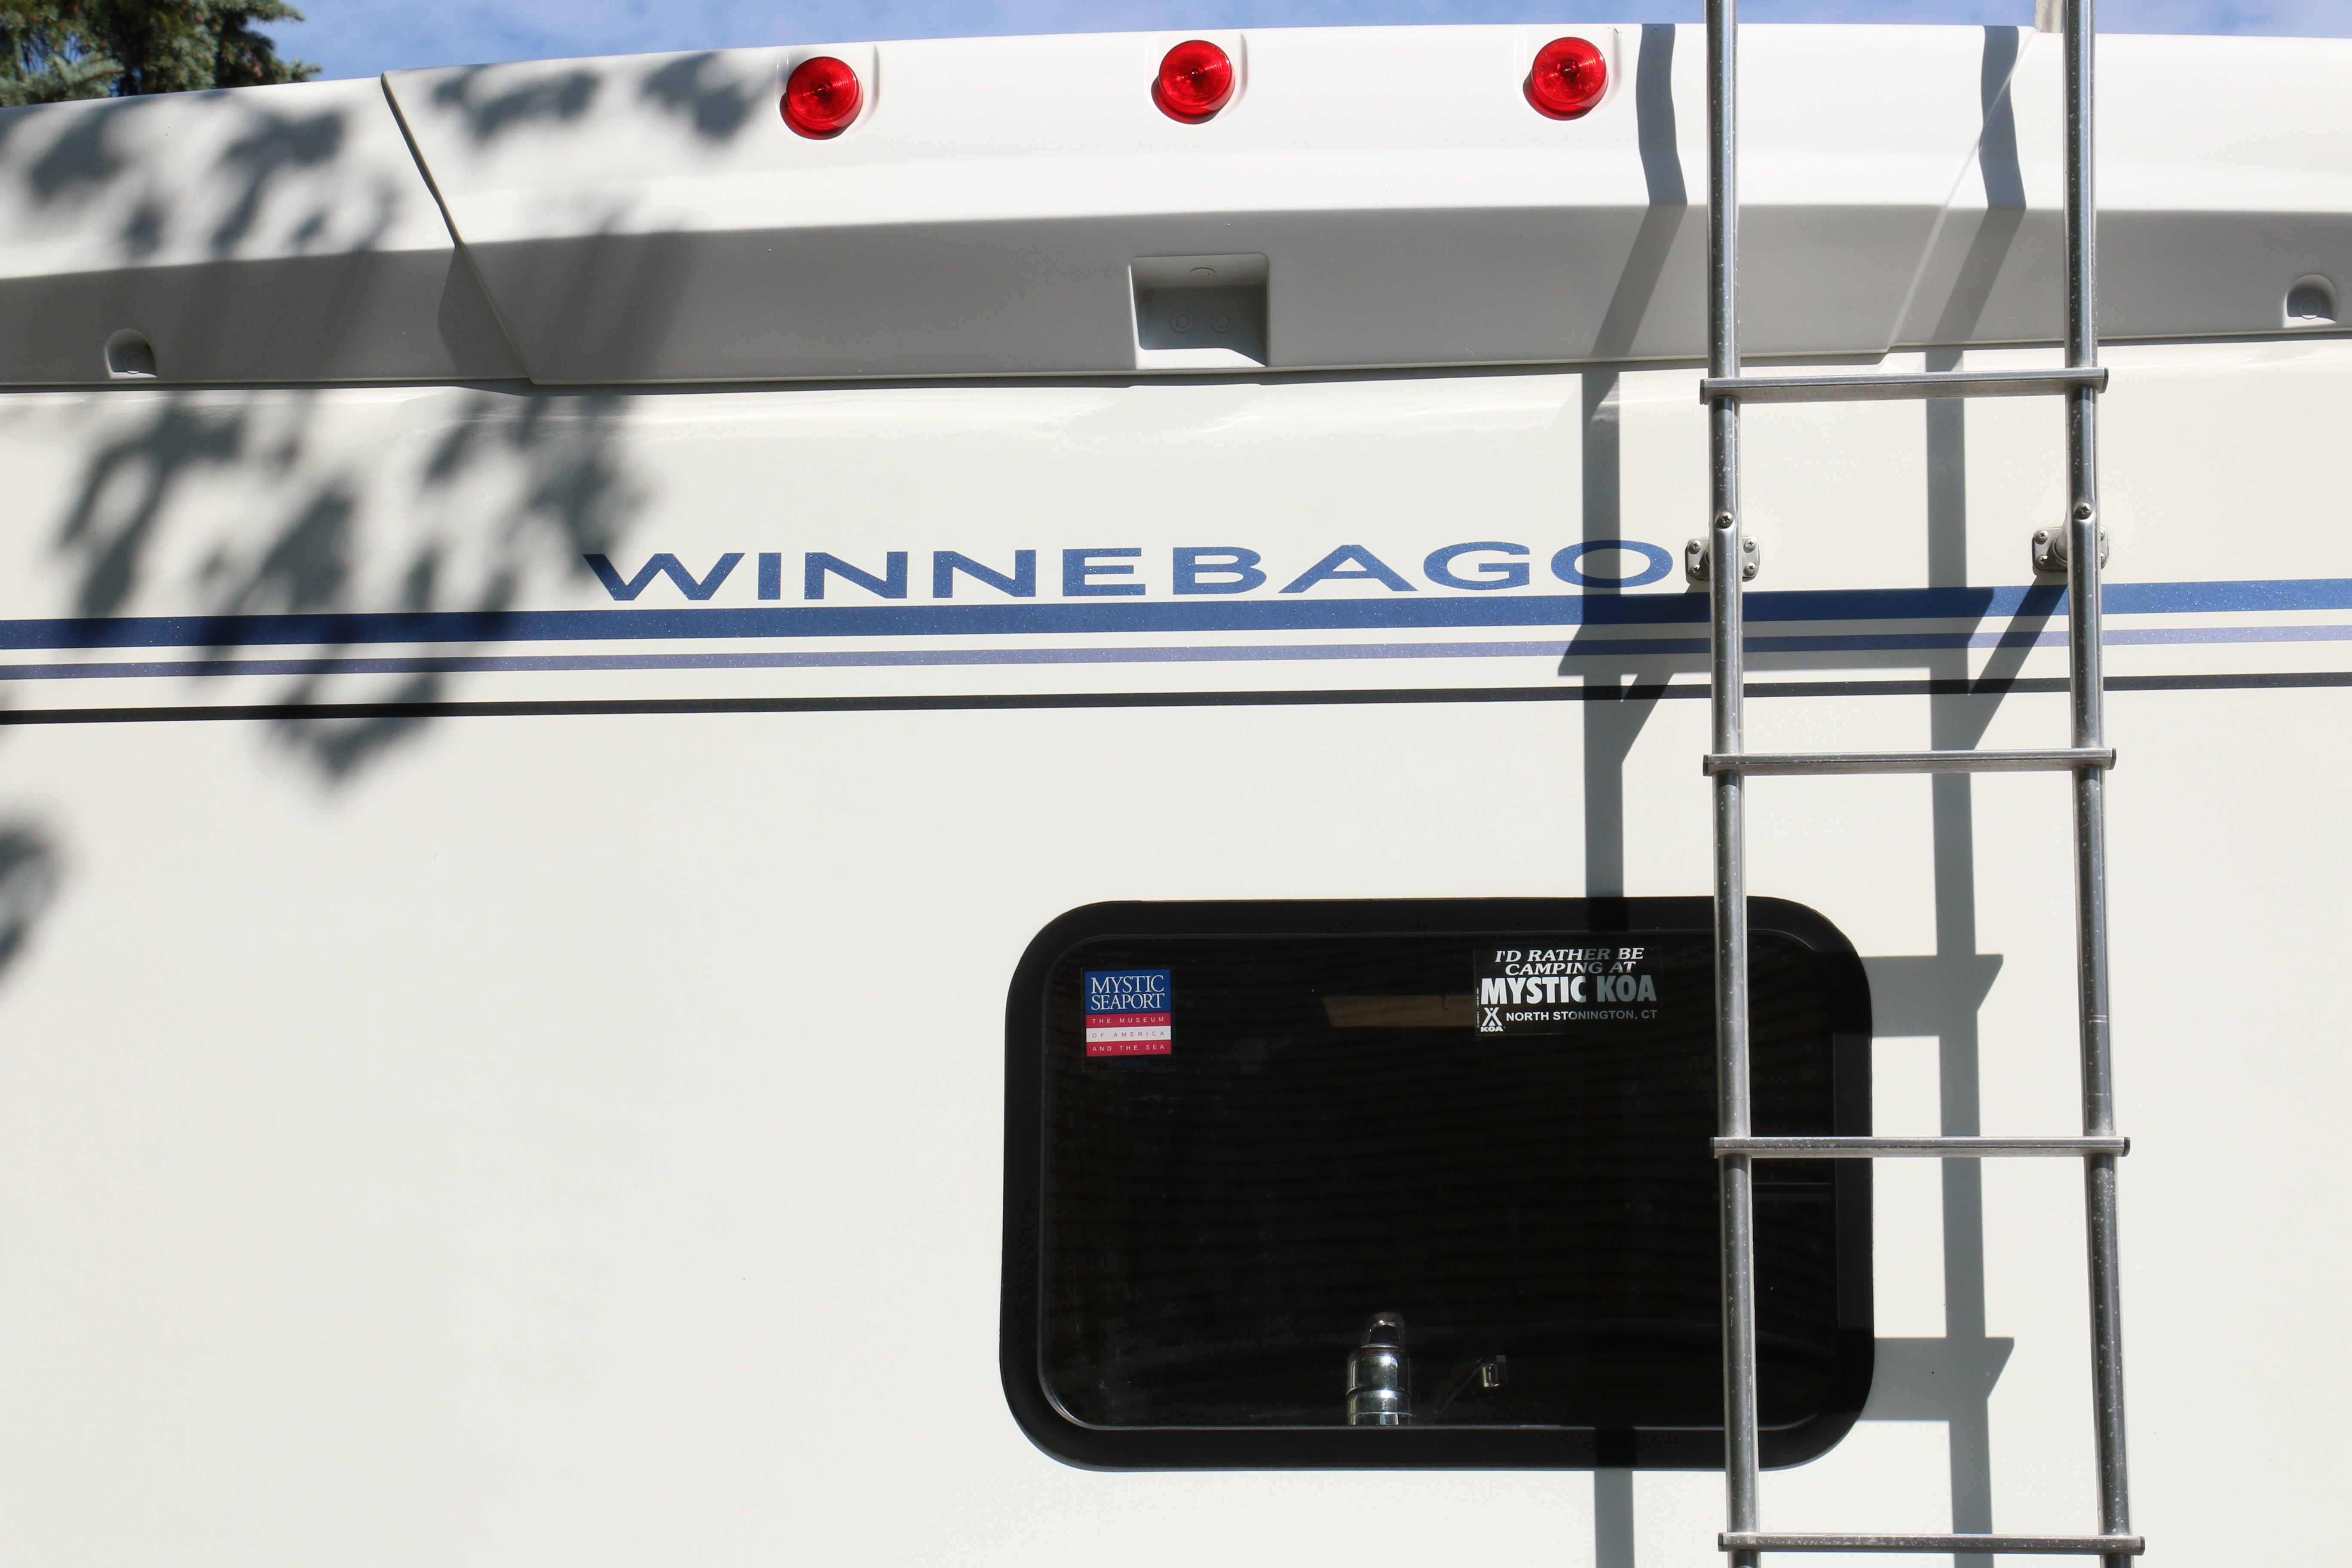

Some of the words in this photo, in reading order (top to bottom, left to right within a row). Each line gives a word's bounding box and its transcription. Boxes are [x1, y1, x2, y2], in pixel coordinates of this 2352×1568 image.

[583, 540, 1673, 600] WINNEBAGO
[1495, 950, 1522, 962] I'D
[1527, 949, 1611, 962] RATHER
[1617, 947, 1644, 960] BE
[1505, 962, 1603, 976] CAMPING
[1609, 961, 1636, 973] AT
[1091, 975, 1164, 994] MYSTIC
[1481, 976, 1586, 1005] MYSTIC
[1597, 975, 1657, 1002] KOA
[1091, 993, 1165, 1010] SEAPORT
[1506, 1012, 1549, 1021] NORTH
[1553, 1010, 1638, 1020] STONINGTON,
[1642, 1010, 1657, 1019] CT
